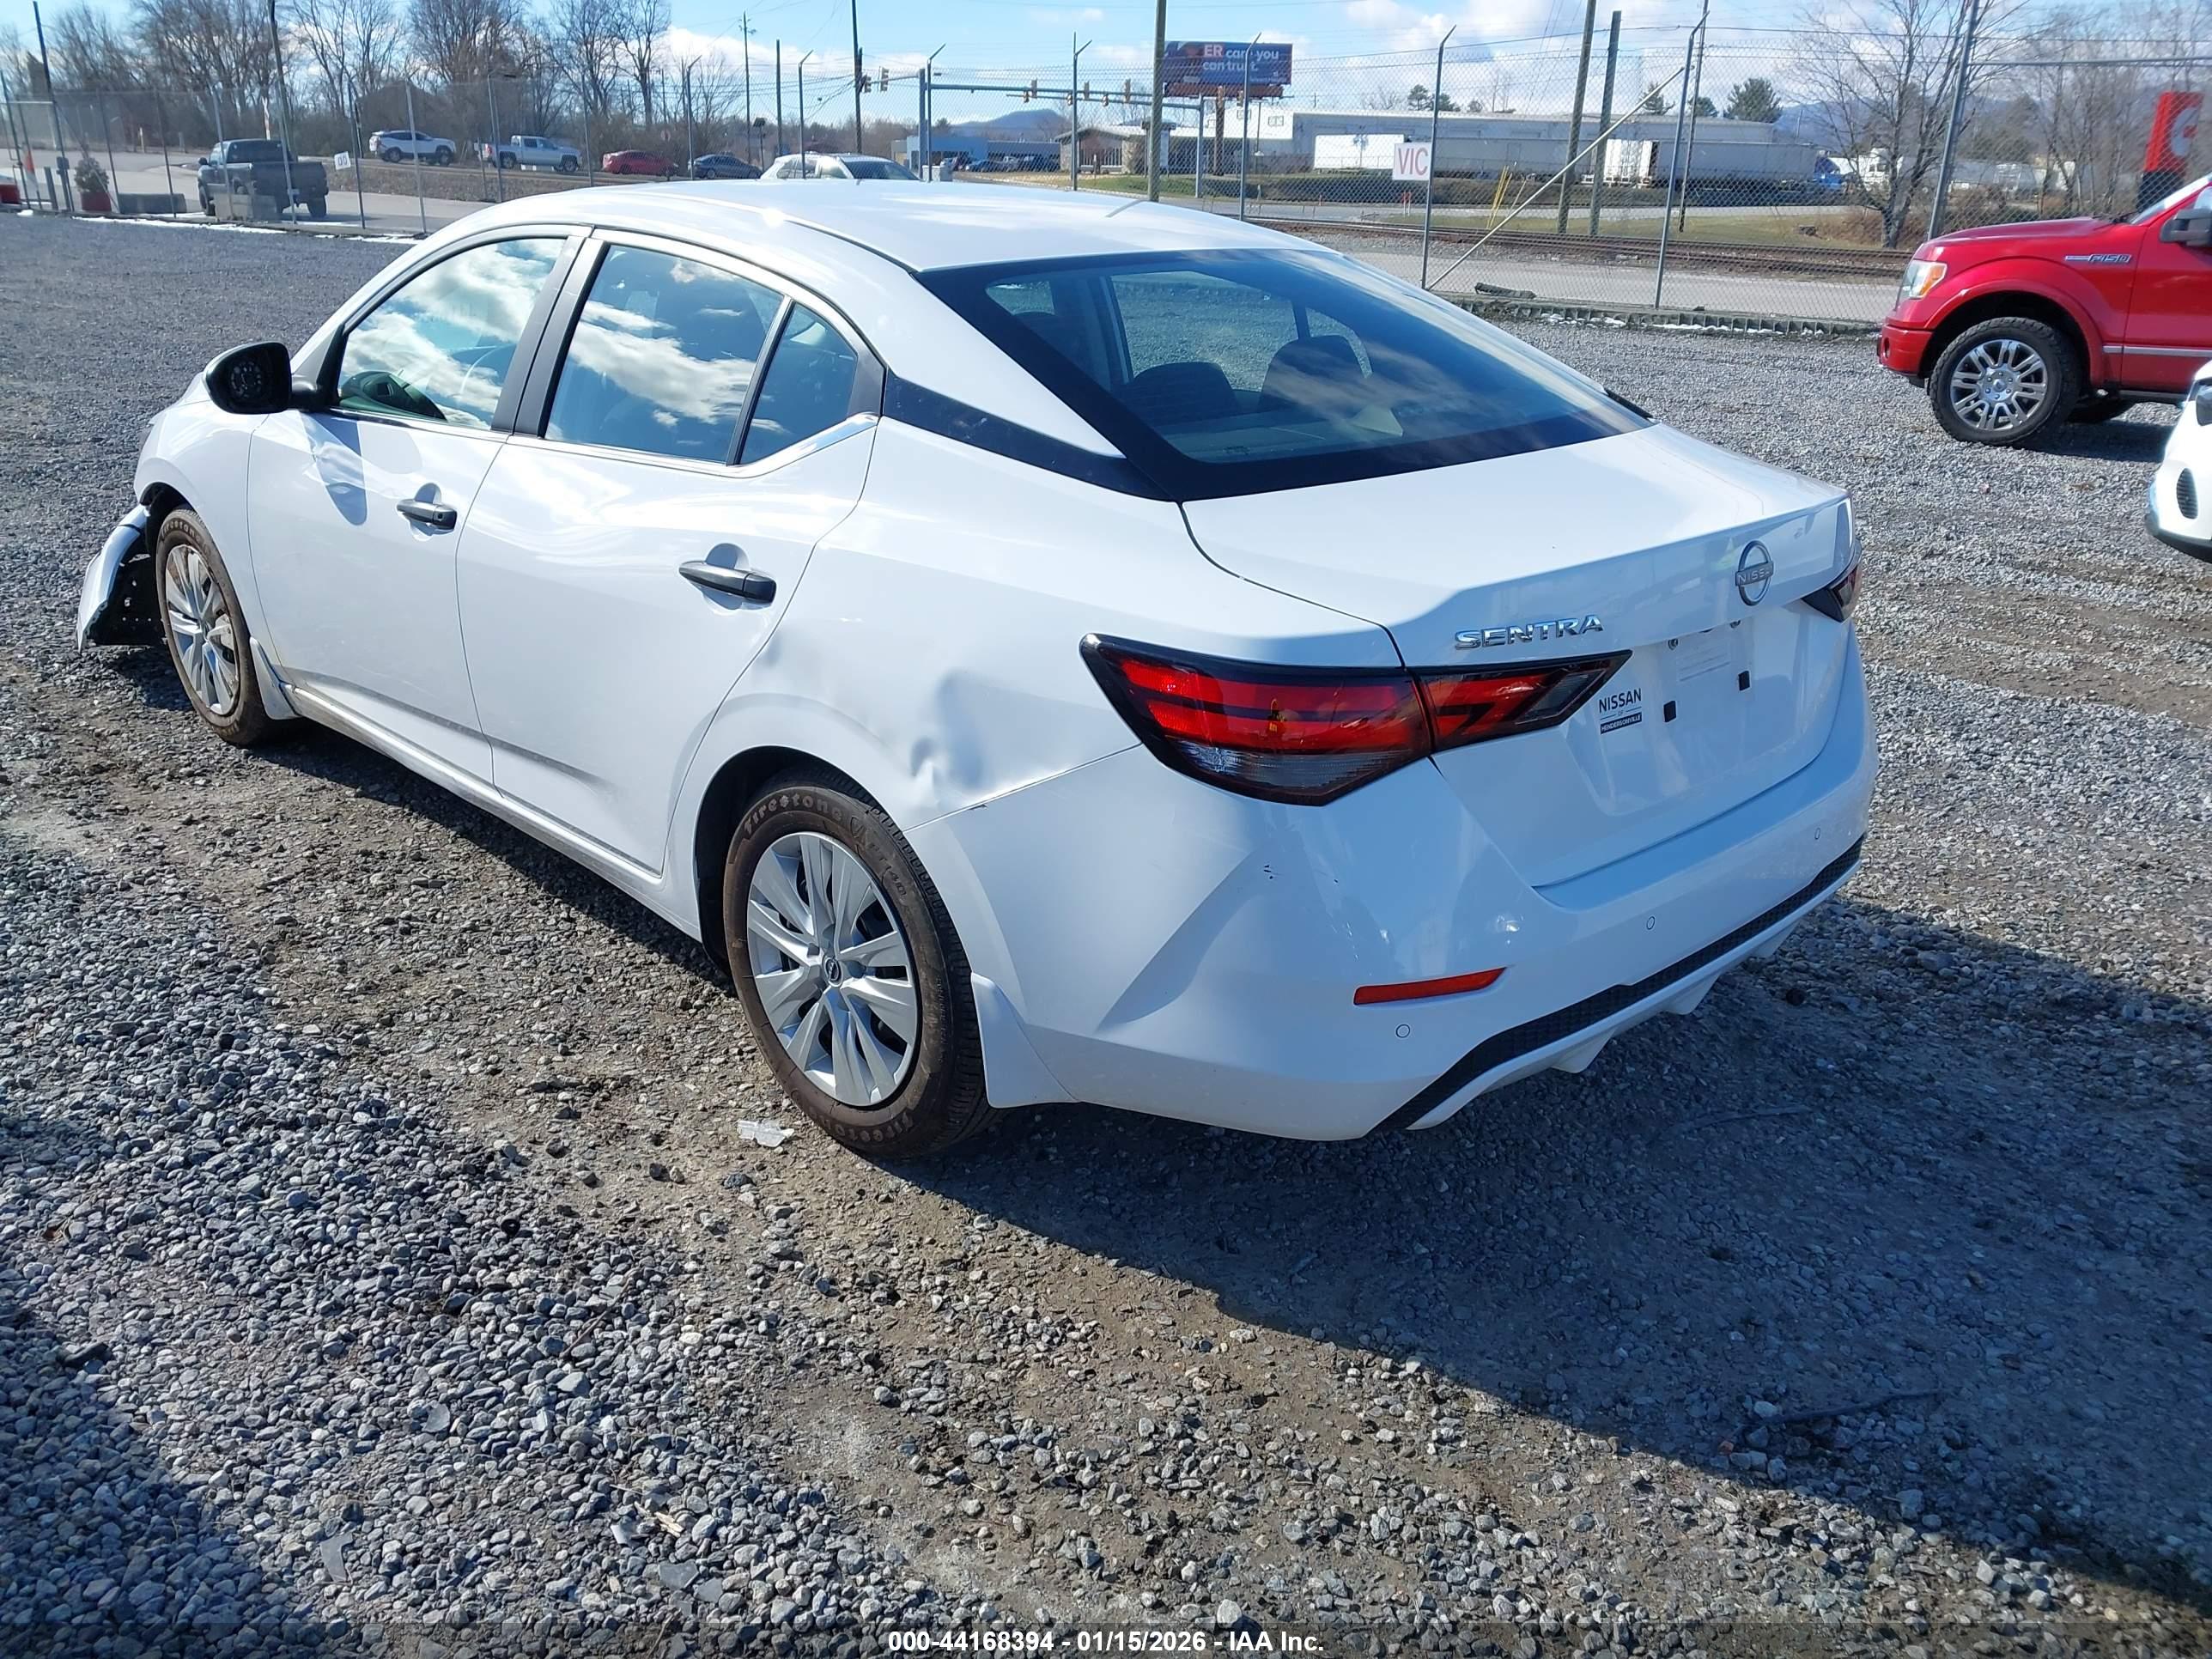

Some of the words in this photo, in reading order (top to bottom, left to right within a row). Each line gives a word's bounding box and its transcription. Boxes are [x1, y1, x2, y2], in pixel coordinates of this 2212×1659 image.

[1202, 60, 1224, 70] can
[1226, 60, 1258, 71] trut.
[1204, 45, 1223, 58] ER
[1225, 49, 1254, 58] car
[1256, 50, 1279, 61] you
[1398, 148, 1428, 176] VIC
[1455, 614, 1604, 650] SENTRA
[1599, 688, 1642, 714] NISSAN
[1601, 714, 1641, 732] HENDERSONVILLE
[744, 793, 842, 836] Firestone
